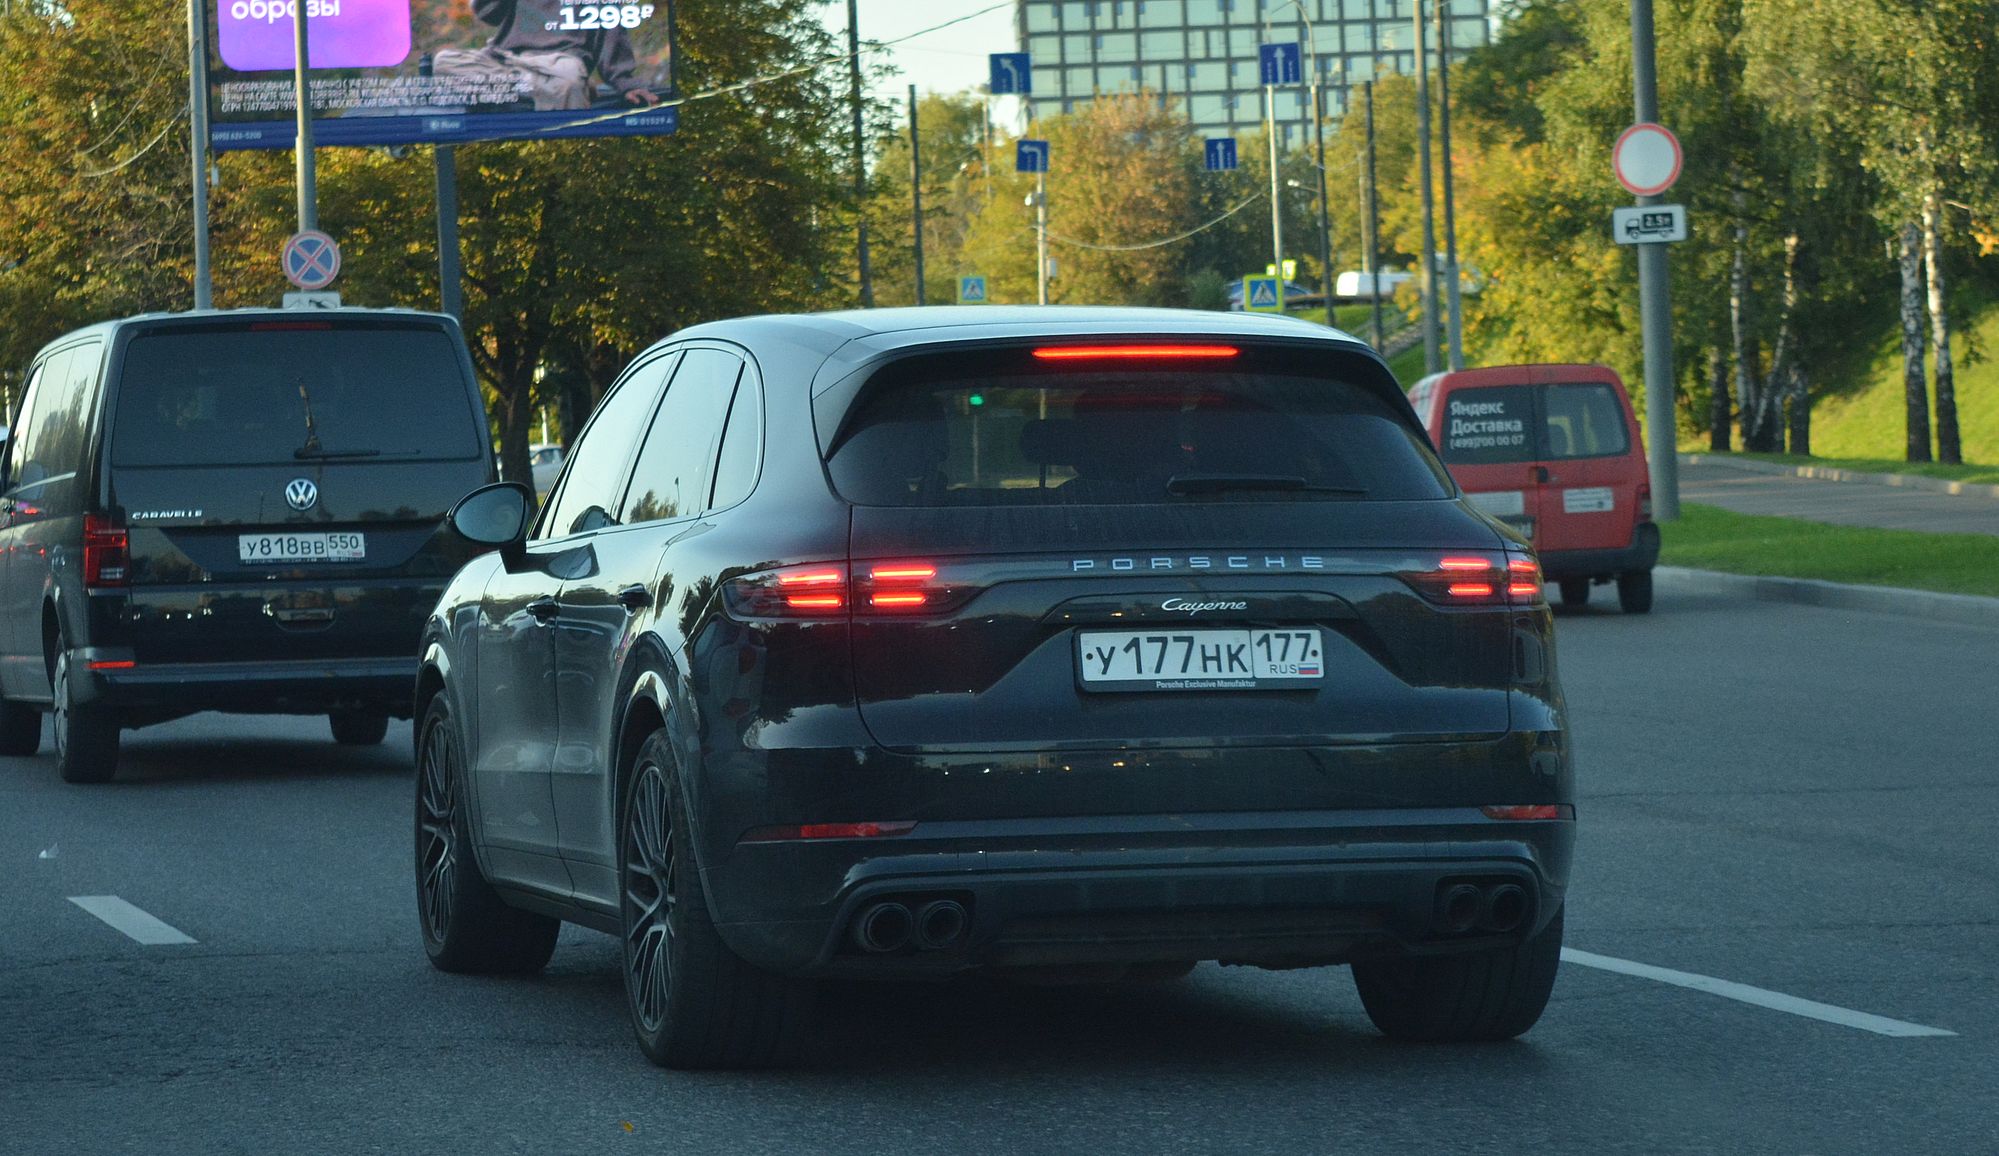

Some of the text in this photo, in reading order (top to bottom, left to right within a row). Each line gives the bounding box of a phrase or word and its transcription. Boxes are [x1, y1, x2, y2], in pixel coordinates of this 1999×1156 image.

[1450, 401, 1504, 416] Яндекс
[1450, 419, 1523, 436] Доставка
[1496, 436, 1510, 446] 00
[1511, 435, 1525, 446] 07
[132, 510, 203, 520] CARAVELLE
[1073, 556, 1324, 571] PORSCHE
[1161, 598, 1248, 616] Cayenne
[1256, 633, 1312, 662] 177
[1269, 664, 1298, 674] RUS
[1156, 679, 1256, 689] Porsche Exclusive Manufaktur
